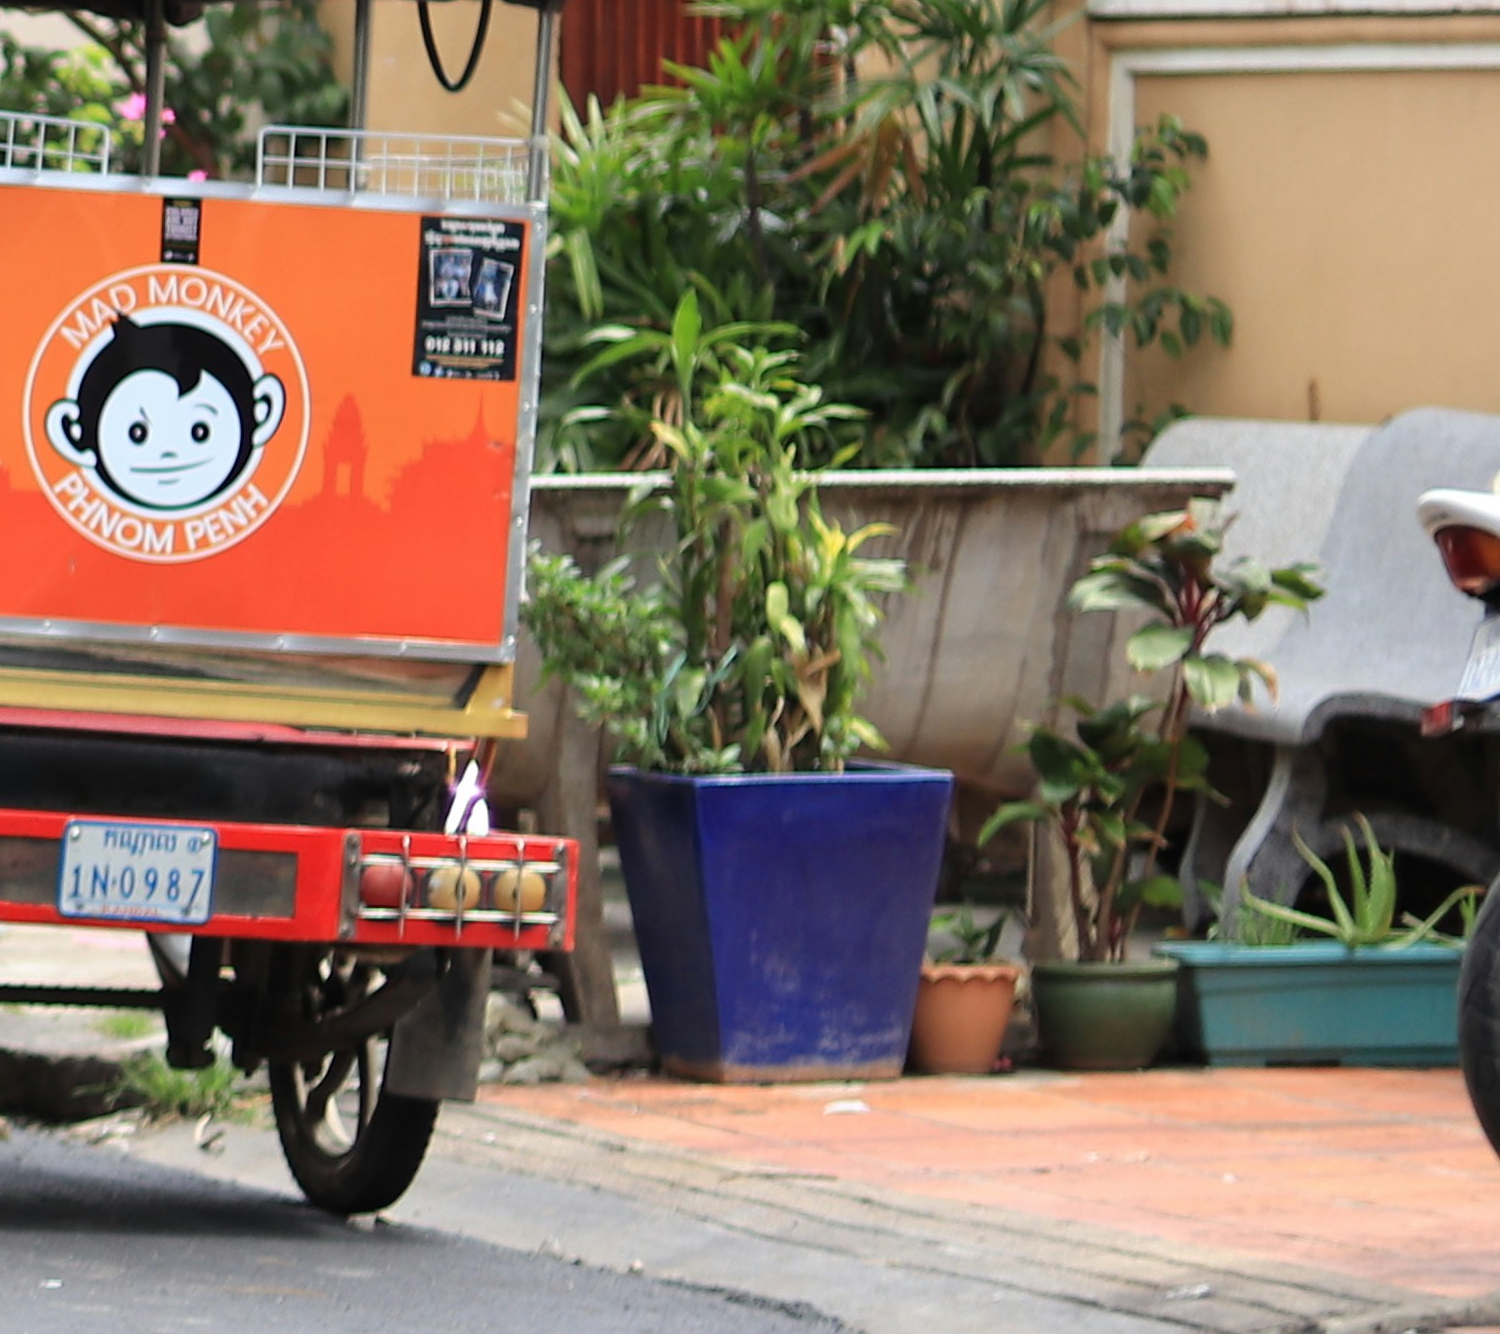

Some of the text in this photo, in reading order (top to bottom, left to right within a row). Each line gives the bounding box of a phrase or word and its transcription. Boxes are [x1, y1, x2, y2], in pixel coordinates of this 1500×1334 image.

[60, 274, 285, 355] MAD MONKEY
[52, 470, 269, 554] PHNOM PENH
